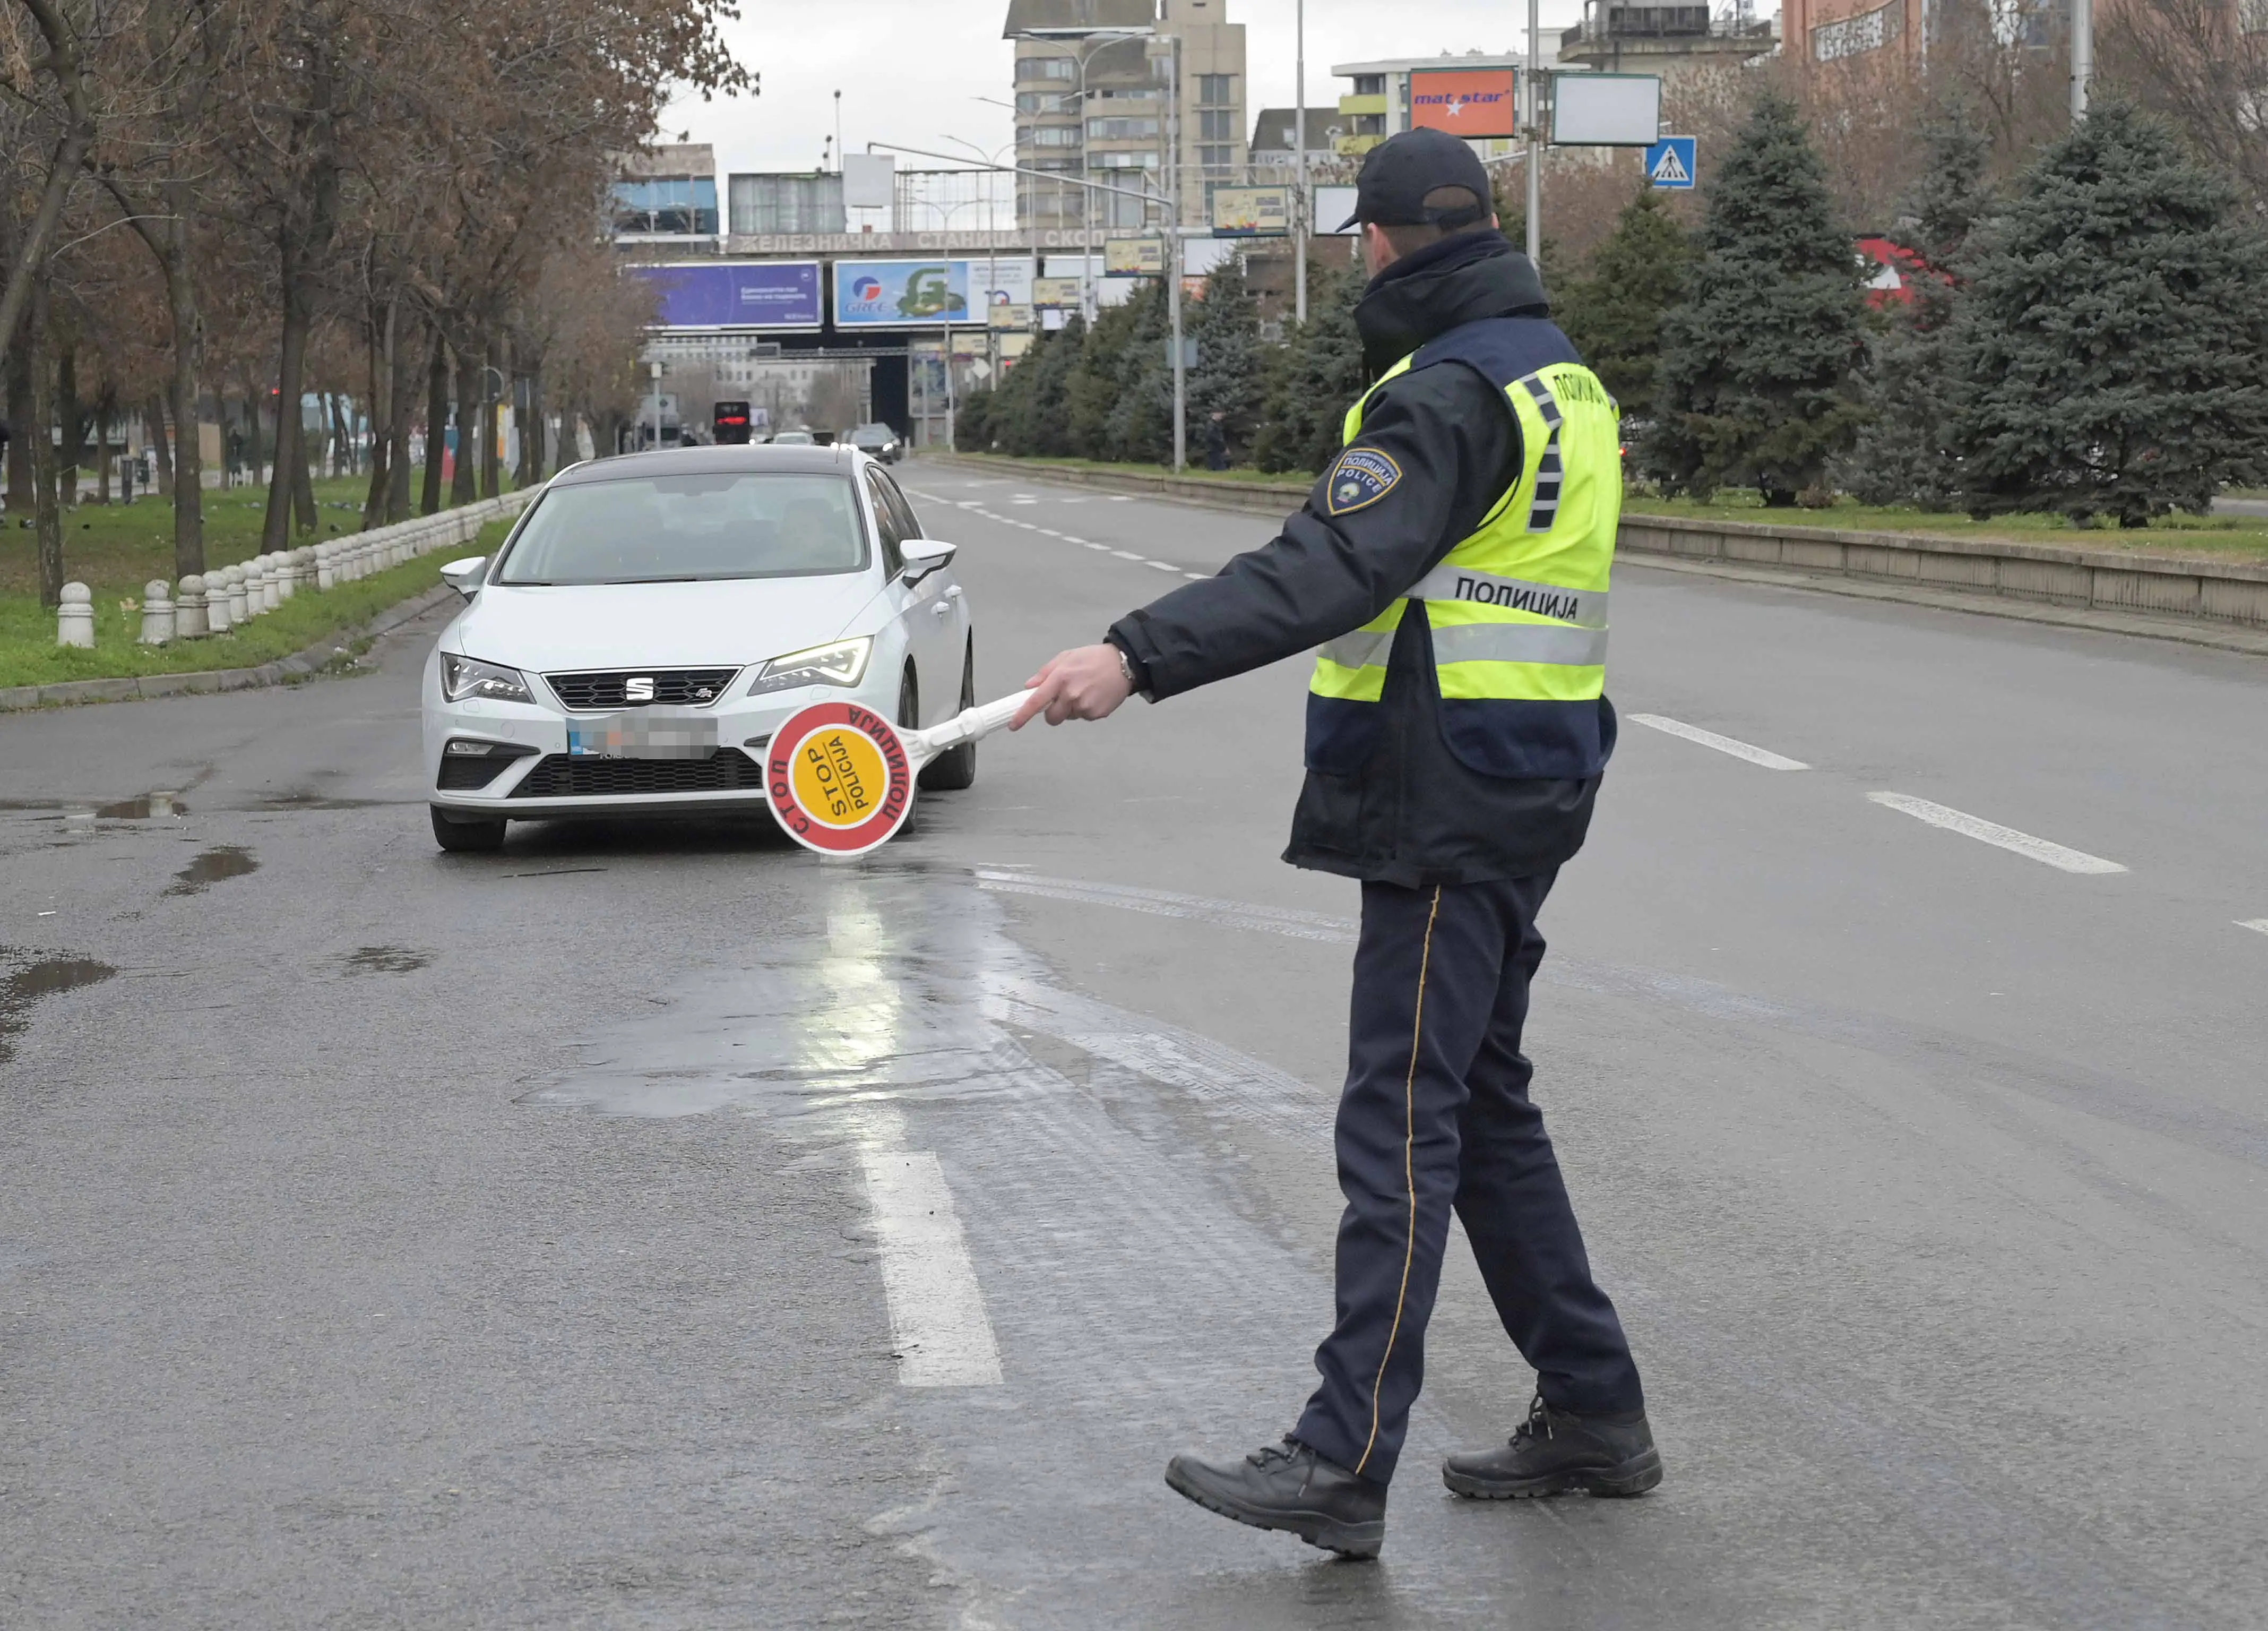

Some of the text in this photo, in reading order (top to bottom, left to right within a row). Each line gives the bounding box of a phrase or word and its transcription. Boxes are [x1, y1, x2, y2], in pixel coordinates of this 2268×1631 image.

[1415, 93, 1453, 105] mat
[739, 234, 893, 252] ЖЕЛЕЗНИЧКА
[917, 231, 1023, 250] СТАНИЦА
[844, 302, 889, 313] GREE
[1336, 469, 1382, 493] POLICE
[1343, 457, 1393, 486] ПОЛИЦИЈА
[1455, 577, 1579, 620] ПОЛИЦИЈА
[829, 735, 869, 810] POLICIJA
[848, 707, 907, 821] ПОЛИЦИЈА
[772, 760, 809, 834] СТОП
[807, 748, 848, 817] STOP
